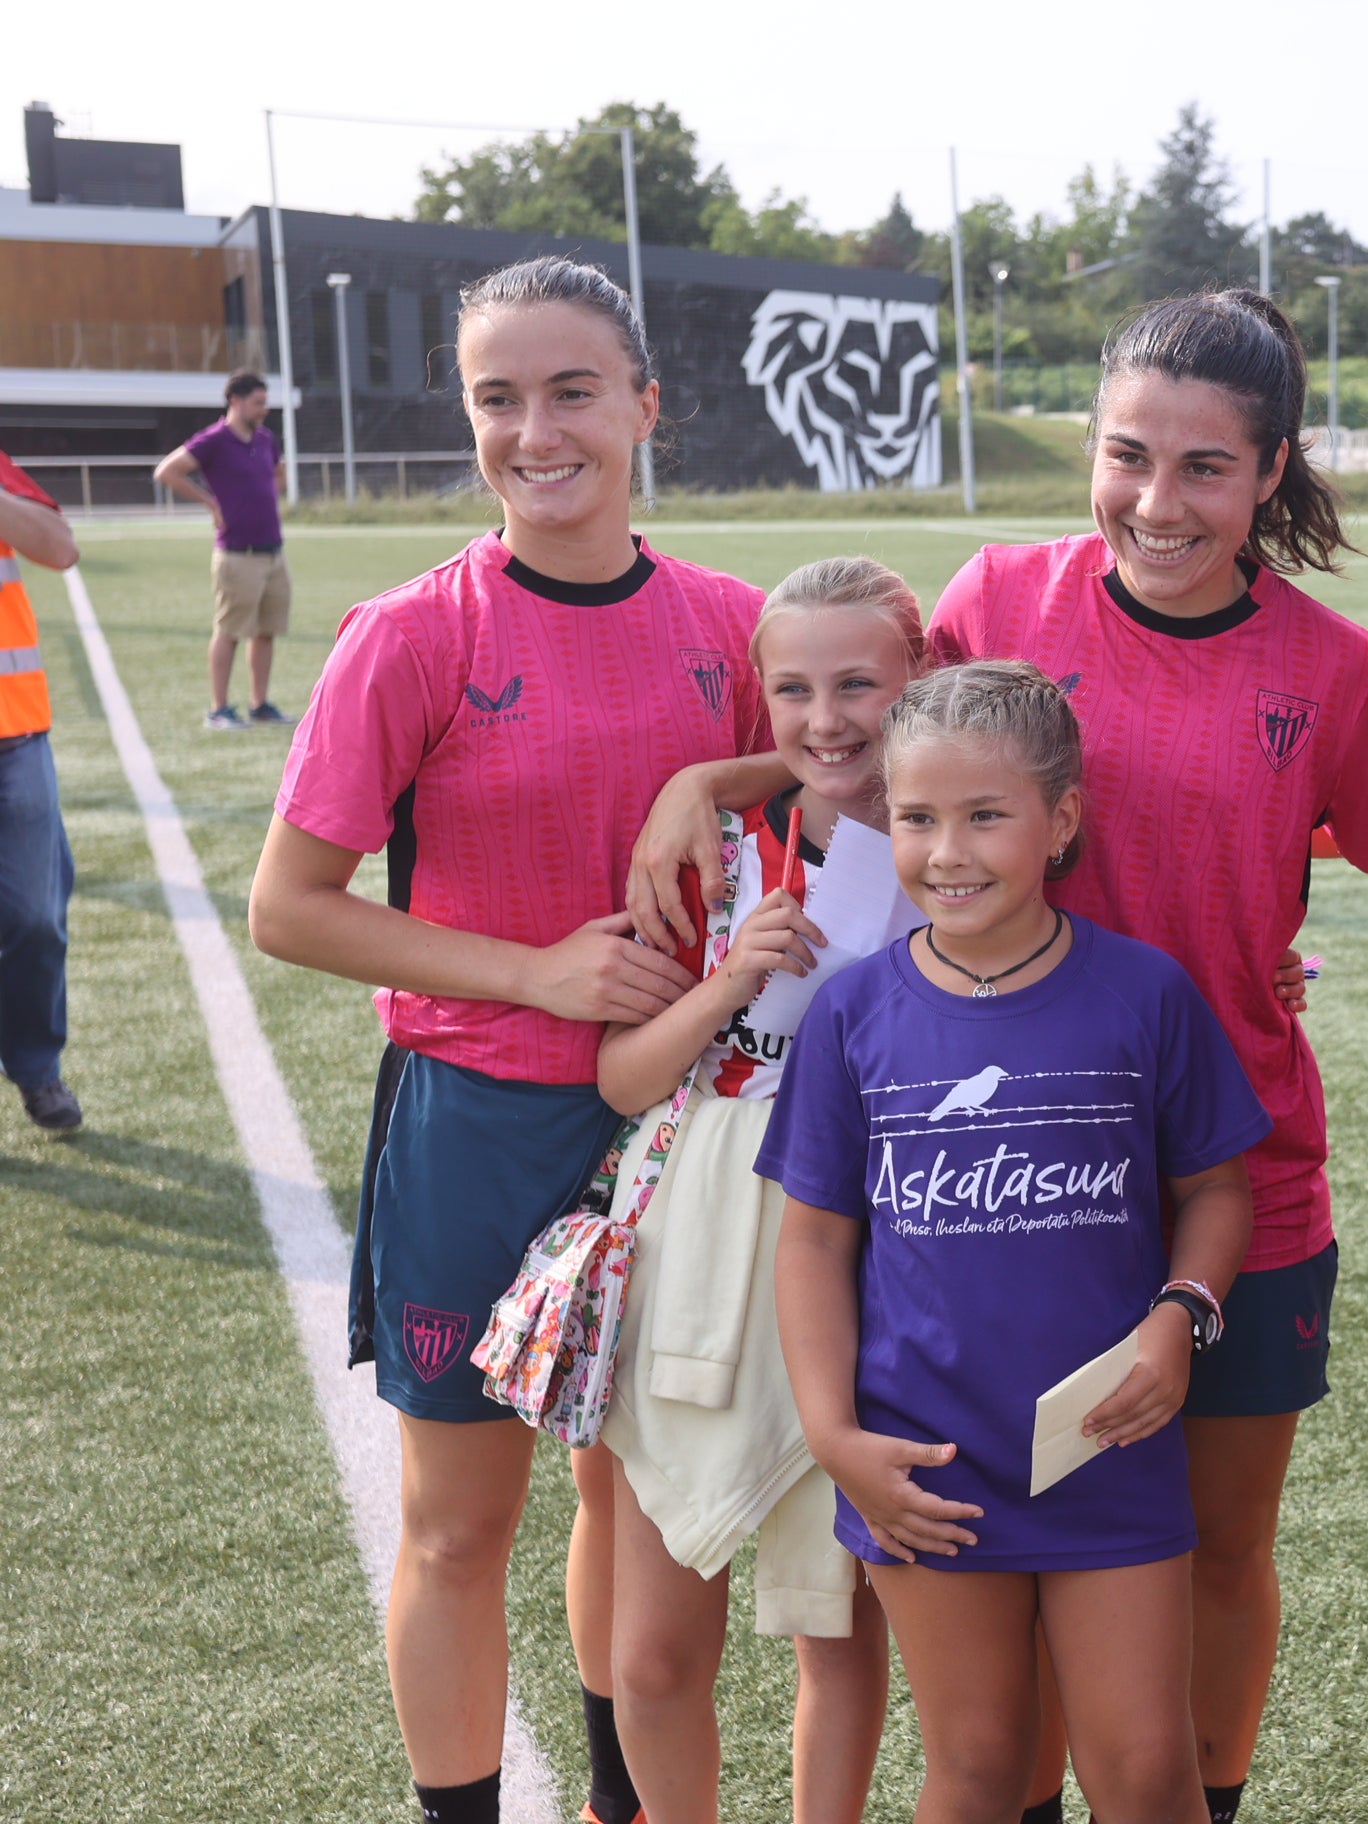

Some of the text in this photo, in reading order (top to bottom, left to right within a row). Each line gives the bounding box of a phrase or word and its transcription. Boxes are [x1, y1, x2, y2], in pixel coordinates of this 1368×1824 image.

[1262, 693, 1315, 711] ATHLETIC CLUB
[470, 712, 527, 728] CASTORE
[872, 1141, 1131, 1221] Askatasuna
[986, 1217, 1006, 1234] eta
[1005, 1213, 1070, 1235] Deportatu
